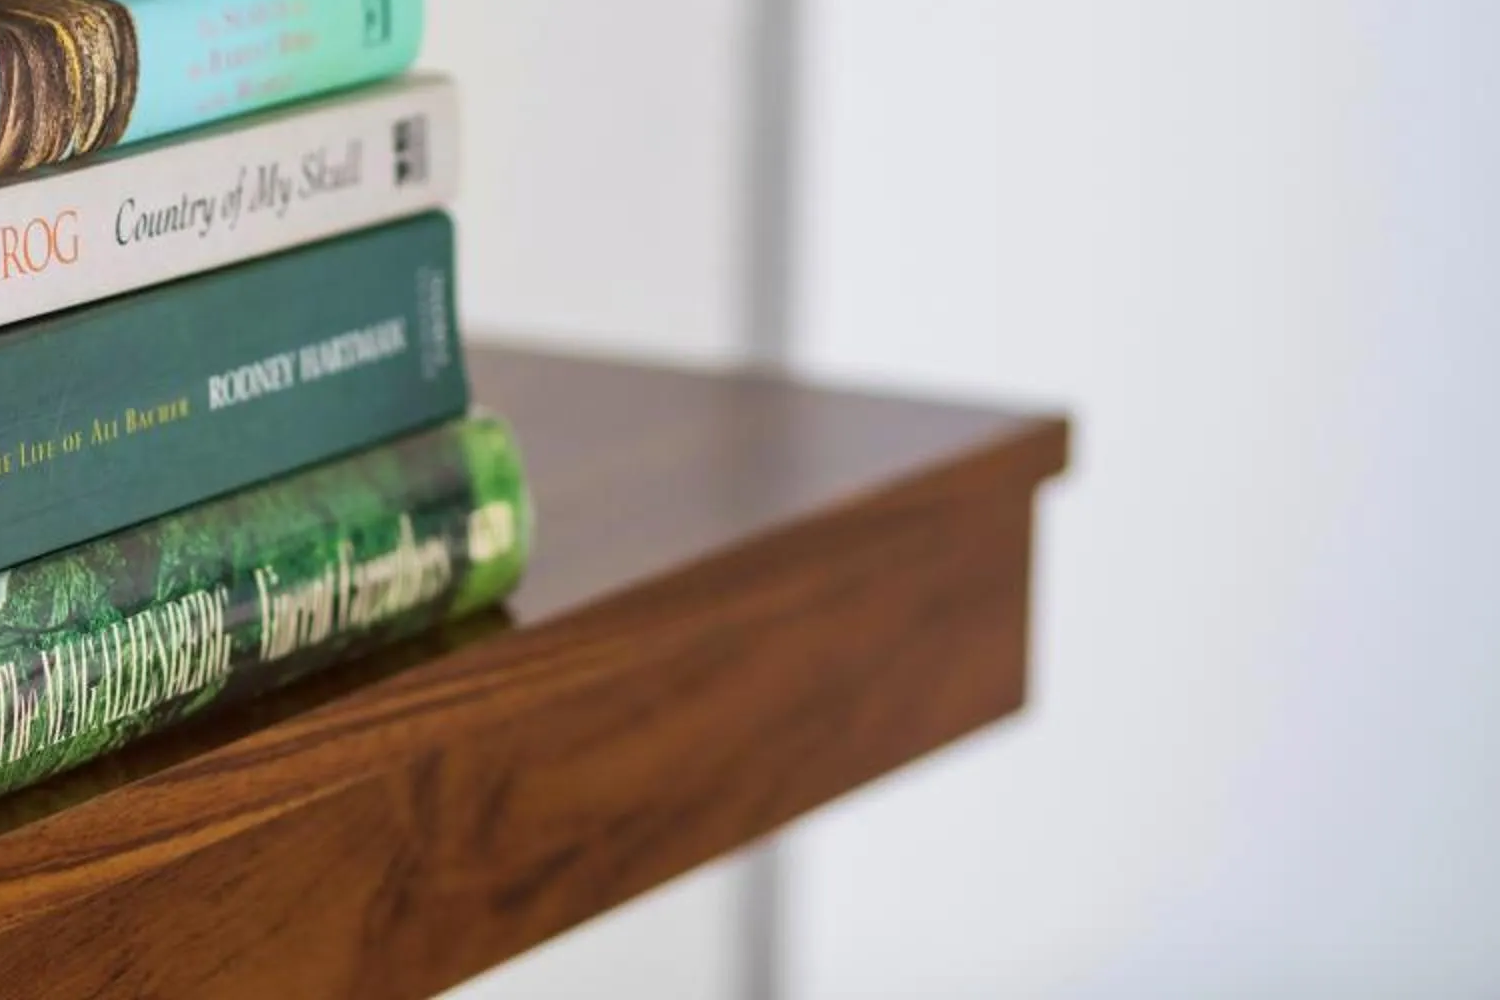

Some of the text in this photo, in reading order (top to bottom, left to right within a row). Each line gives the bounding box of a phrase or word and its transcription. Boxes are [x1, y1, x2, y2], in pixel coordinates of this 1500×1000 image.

[114, 138, 364, 247] Country of My Skull
[208, 350, 297, 412] RODNEY
